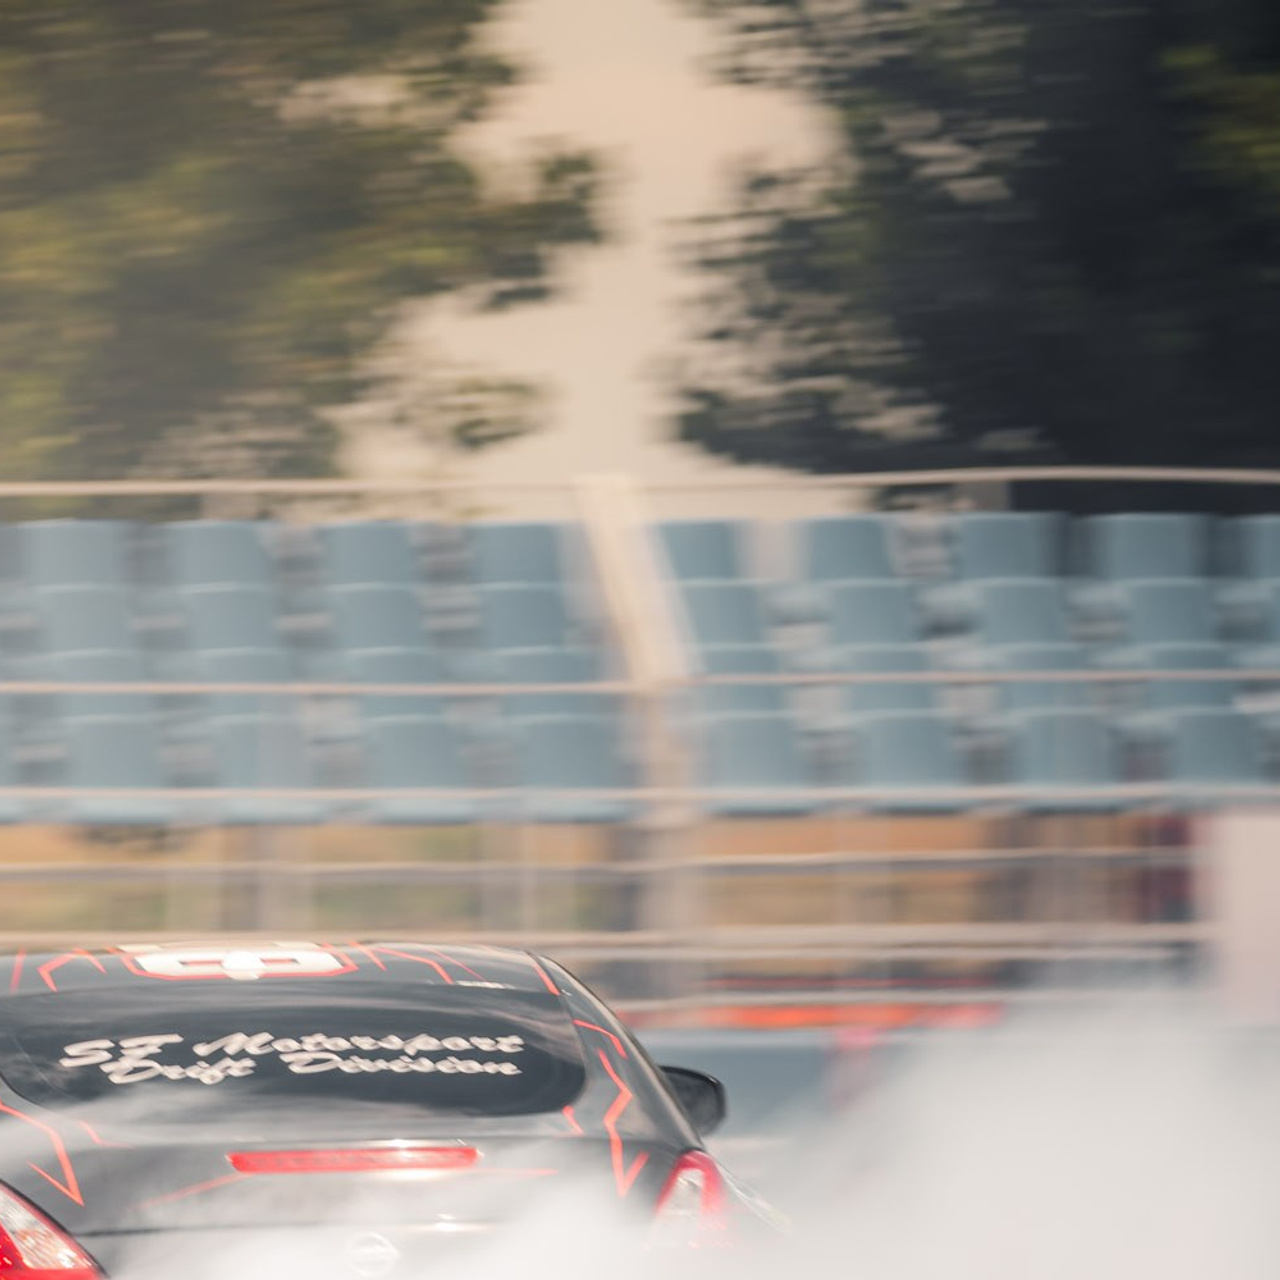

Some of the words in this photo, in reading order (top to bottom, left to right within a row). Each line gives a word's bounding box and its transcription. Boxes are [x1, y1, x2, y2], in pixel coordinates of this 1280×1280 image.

[192, 1032, 524, 1056] Motorsport
[99, 1056, 257, 1085] Drift
[278, 1050, 523, 1076] Division
